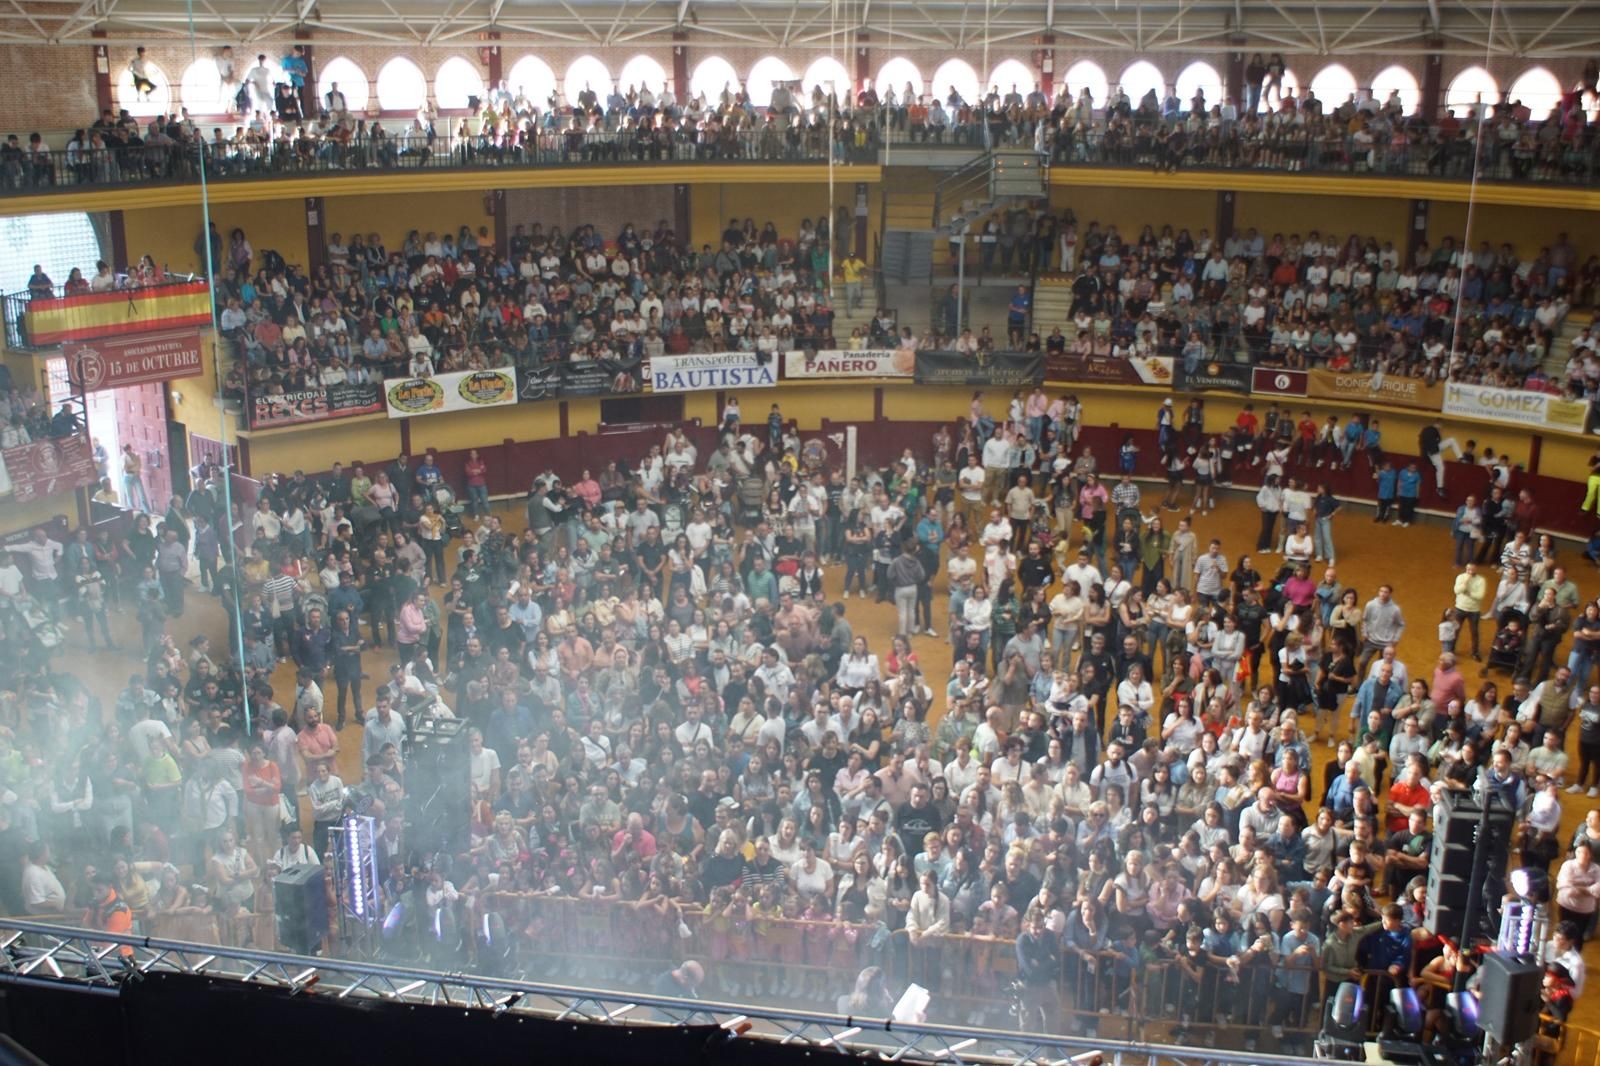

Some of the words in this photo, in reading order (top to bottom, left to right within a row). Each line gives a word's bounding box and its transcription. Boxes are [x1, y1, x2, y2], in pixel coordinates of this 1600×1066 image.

[110, 361, 122, 376] 15
[126, 361, 139, 374] DE
[142, 350, 199, 370] OCTUBRE
[673, 354, 756, 367] TRANSPORTES
[805, 357, 877, 373] PAÑERO
[655, 367, 774, 390] BAUTISTA
[1335, 376, 1417, 394] DONFARIQUE
[255, 390, 328, 405] ELETRICIDAD
[1478, 390, 1545, 413] GOMEZ
[255, 398, 329, 423] REYES
